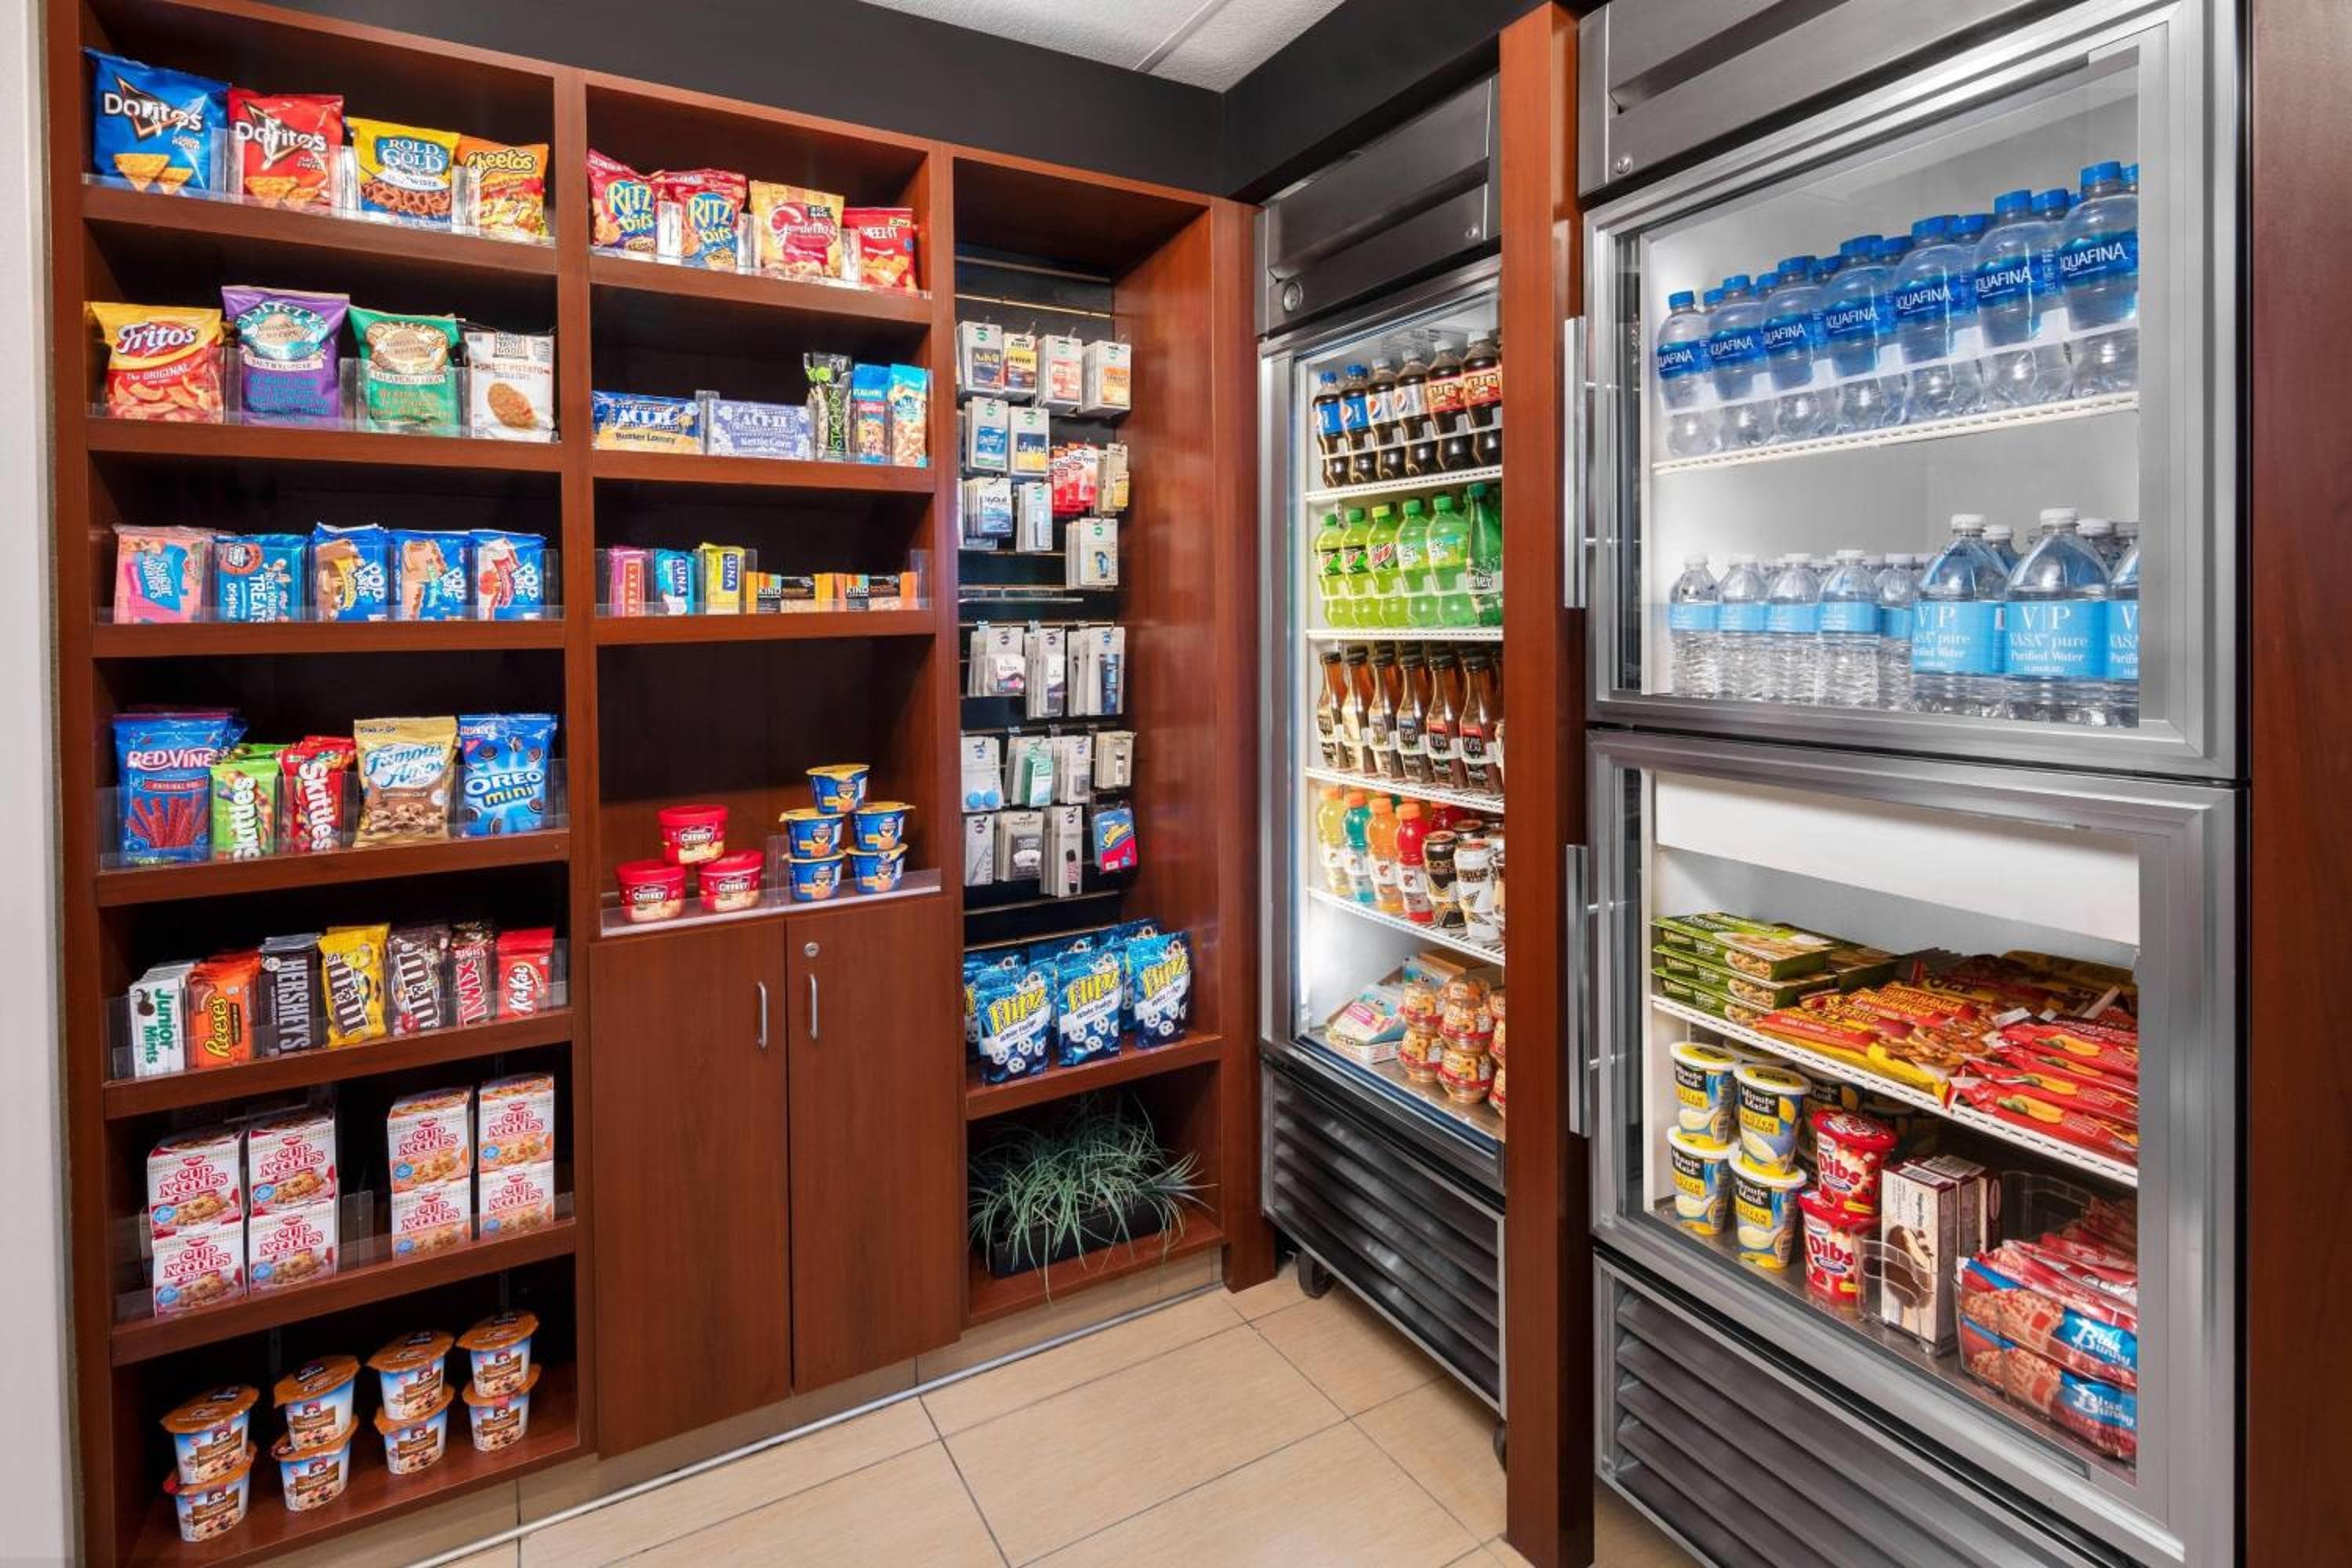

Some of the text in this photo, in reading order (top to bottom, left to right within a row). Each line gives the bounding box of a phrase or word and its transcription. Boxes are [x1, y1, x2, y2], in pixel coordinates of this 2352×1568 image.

[103, 93, 202, 132] Doritos
[234, 121, 328, 152] Doritos
[389, 139, 439, 155] ROLD
[382, 148, 443, 172] GOLD
[466, 148, 535, 174] Cheetos
[608, 181, 652, 215] RITZ
[689, 196, 734, 229] RITZ
[118, 321, 198, 354] Fritos
[141, 555, 162, 600] Wafers
[155, 561, 174, 597] Sugar
[675, 558, 688, 596] LUNA
[725, 554, 737, 592] LUNA
[758, 586, 782, 597] KIND
[846, 586, 869, 596] KIND
[465, 771, 543, 795] OREO
[485, 786, 535, 807] mini
[232, 776, 261, 858] Skittles
[297, 762, 337, 851] Skittles
[155, 988, 176, 1050] Junior
[204, 996, 231, 1058] Reese's
[143, 1025, 158, 1065] Mints
[412, 1125, 446, 1142] CUP
[502, 1110, 534, 1126] CUP
[274, 1143, 313, 1162] CUP
[176, 1164, 214, 1182] CUP
[1818, 1152, 1861, 1185] Dibs
[502, 1181, 534, 1199] CUP
[415, 1200, 449, 1217] CUP
[274, 1224, 311, 1243] CUP
[180, 1245, 219, 1262] CUP
[1807, 1233, 1854, 1266] Dibs
